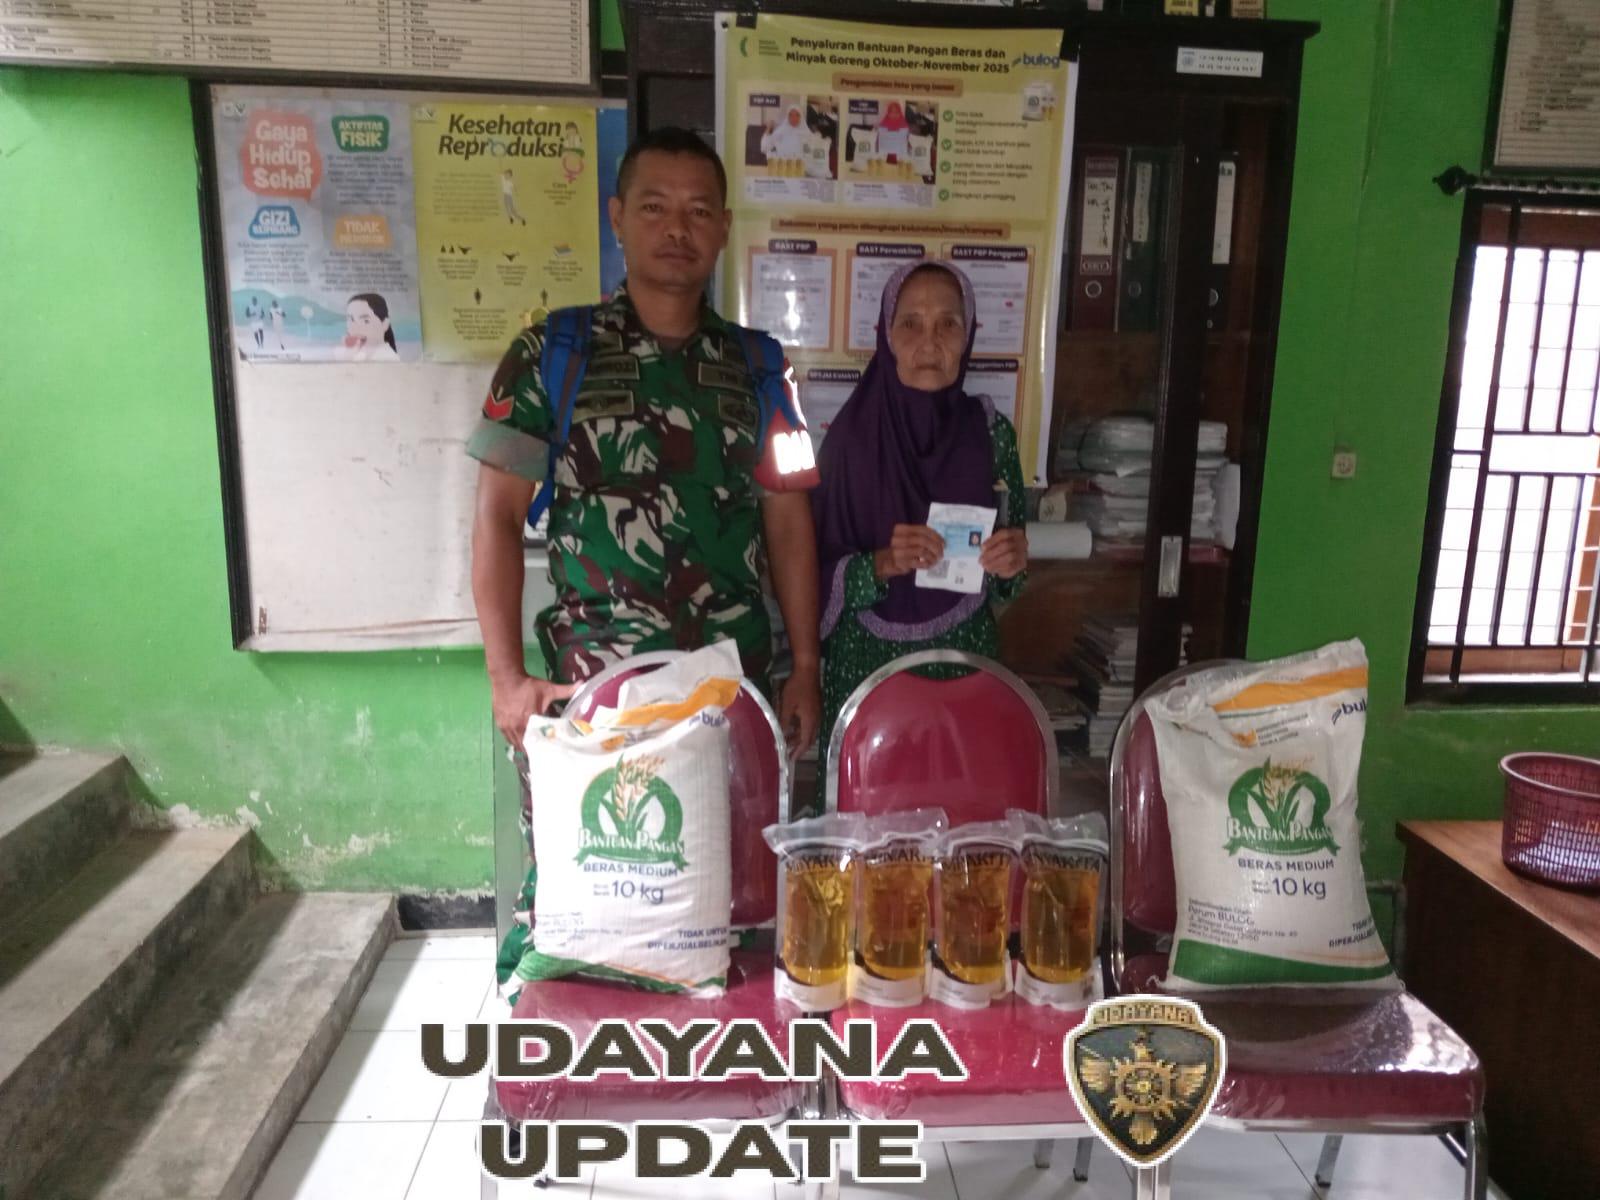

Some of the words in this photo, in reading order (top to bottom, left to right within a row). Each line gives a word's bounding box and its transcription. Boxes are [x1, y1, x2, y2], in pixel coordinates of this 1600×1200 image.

[790, 36, 855, 53] Penyaluran
[856, 42, 905, 54] Bantuan
[907, 45, 948, 58] Pangan
[951, 47, 982, 59] Beras
[984, 49, 1006, 59] dan
[786, 52, 826, 67] Minyak
[829, 55, 871, 68] Goreng
[873, 57, 980, 73] Oktober-November
[982, 62, 1009, 74] 2025
[1023, 53, 1061, 69] bulog
[256, 120, 308, 148] Gaya
[449, 113, 562, 137] Kesehatan
[340, 131, 382, 148] FISIK
[438, 135, 565, 160] Reproduksi
[250, 143, 312, 170] Hidup
[253, 166, 314, 189] Sehat
[258, 208, 291, 226] GIZI
[343, 220, 381, 234] TIDAK
[1227, 816, 1285, 841] BANTUAN
[1289, 819, 1334, 841] PANGAN
[579, 829, 635, 849] BANTUAN
[637, 829, 685, 854] PANGAN
[583, 862, 625, 873] BERAS
[628, 863, 678, 878] MEDIUM
[1238, 857, 1282, 871] BERAS
[1286, 858, 1335, 872] MEDIUM
[611, 880, 636, 898] 10
[640, 882, 664, 905] kg
[1272, 878, 1298, 896] 10
[1303, 877, 1326, 900] kg
[1188, 904, 1216, 919] Perum
[679, 928, 705, 938] TIDAK
